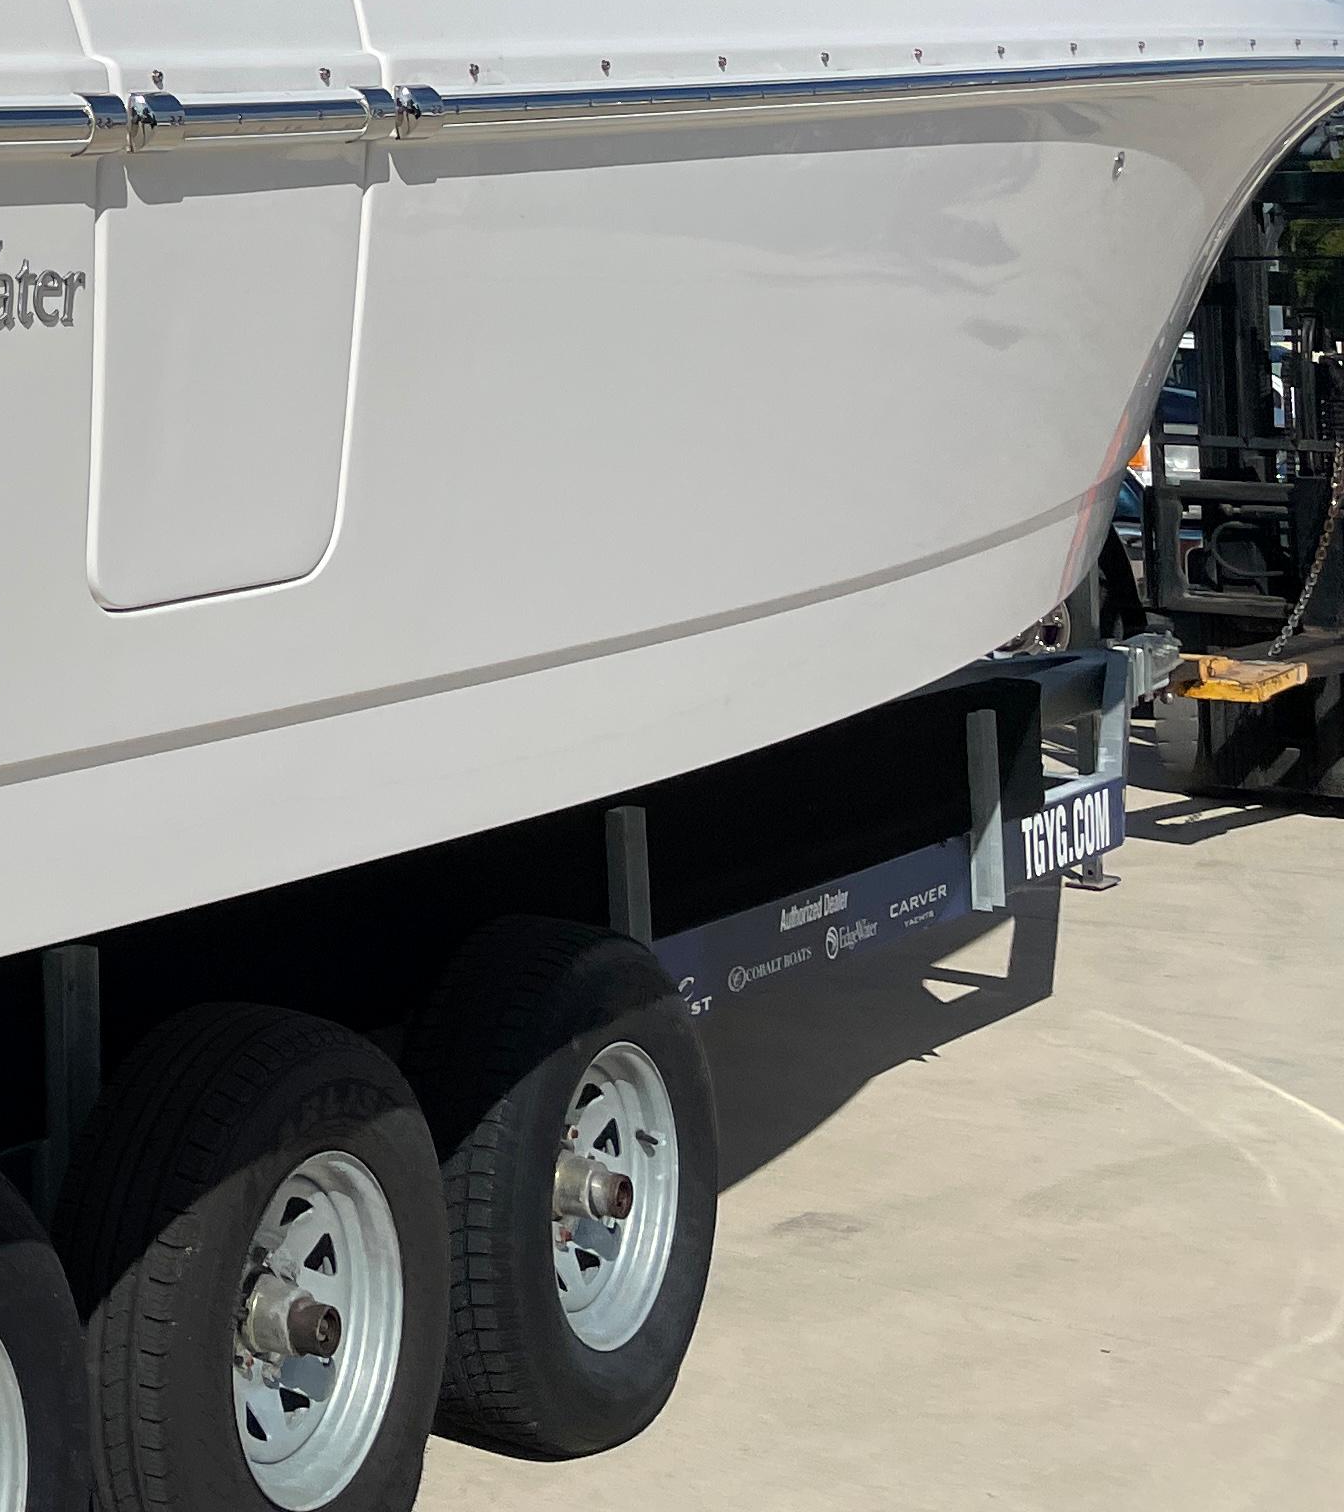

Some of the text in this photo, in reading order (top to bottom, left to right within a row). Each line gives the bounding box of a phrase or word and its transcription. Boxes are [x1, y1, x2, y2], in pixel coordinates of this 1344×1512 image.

[1021, 788, 1110, 880] TGYG.COM
[780, 889, 849, 932] Authorized Dealer
[889, 884, 947, 919] CARVER
[839, 918, 878, 950] EdgeWater
[746, 946, 813, 982] COBALT BOATS
